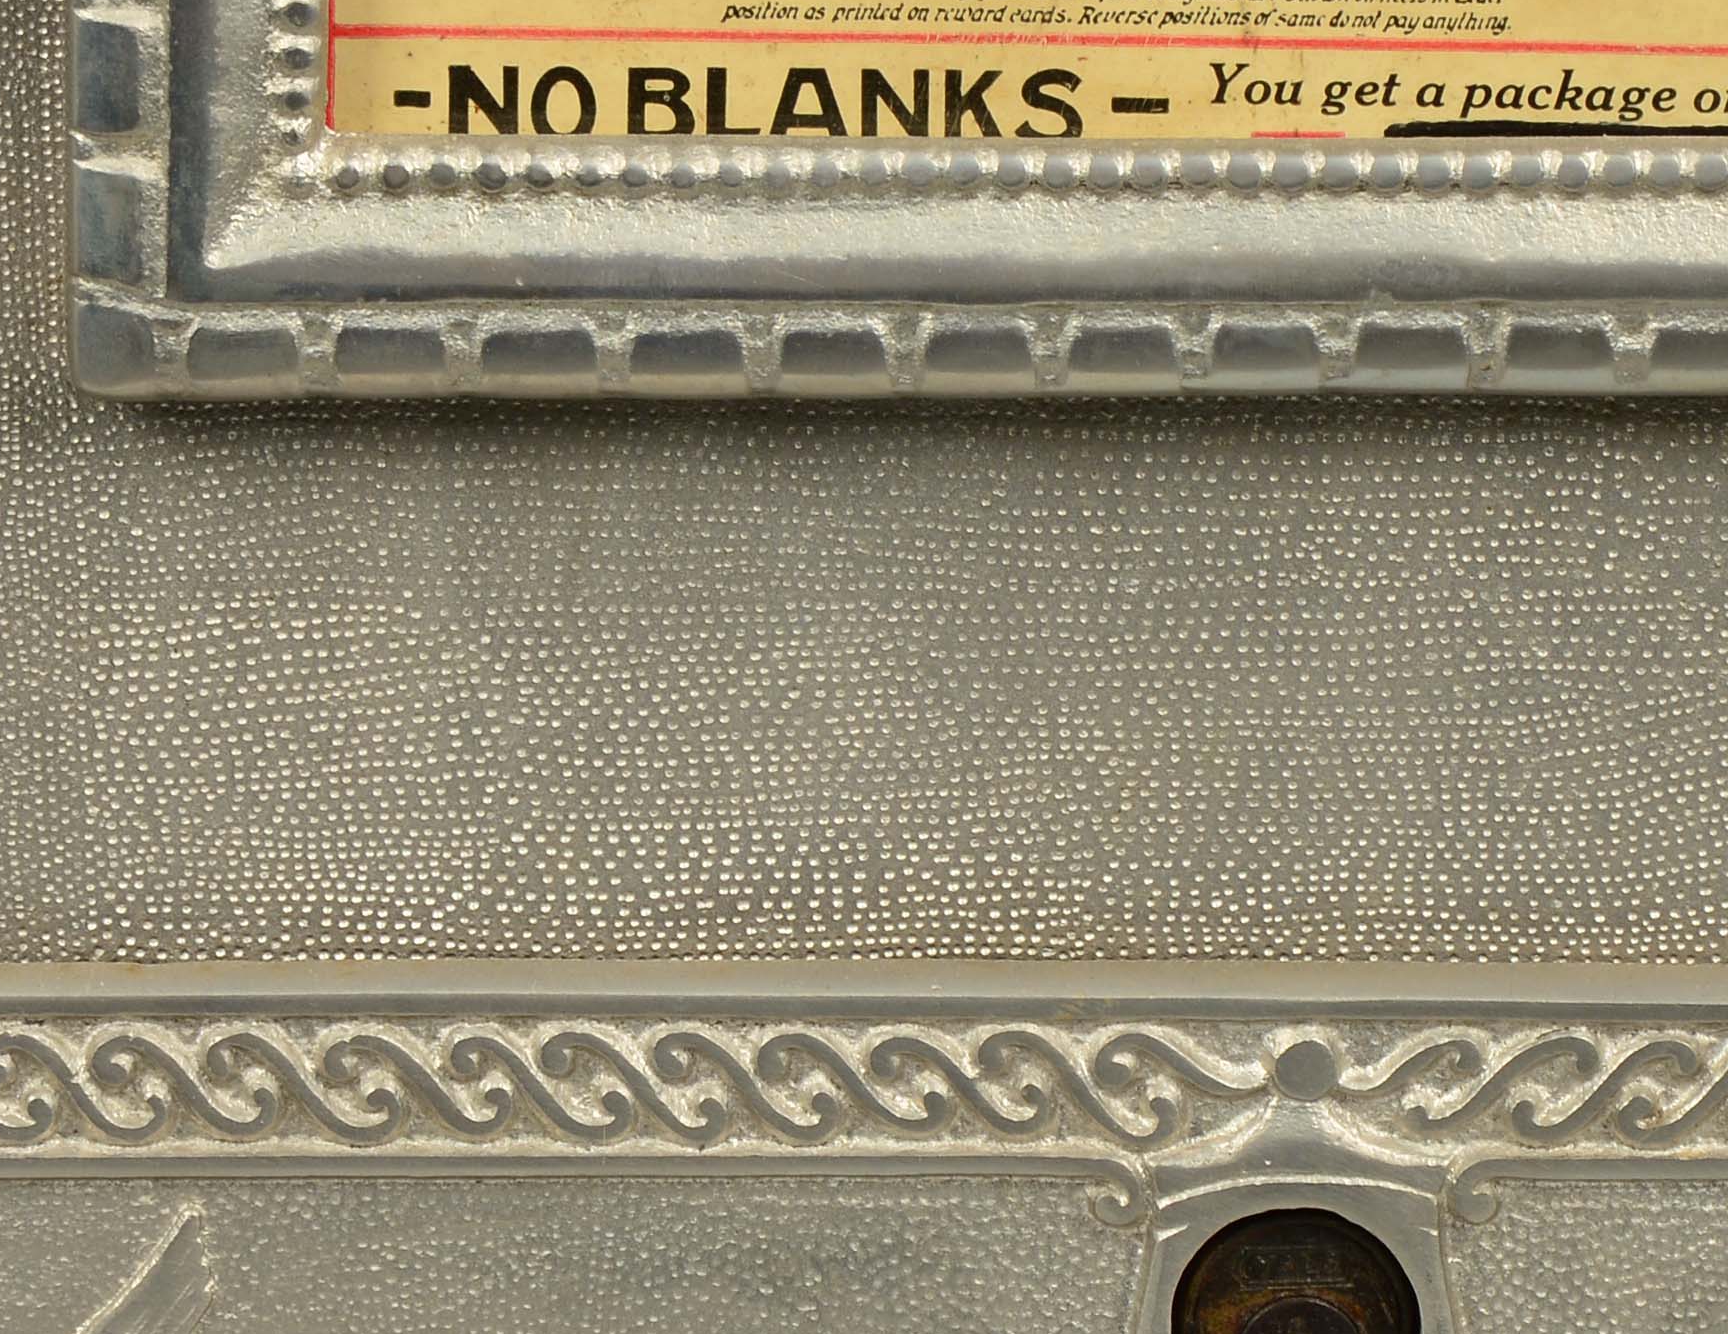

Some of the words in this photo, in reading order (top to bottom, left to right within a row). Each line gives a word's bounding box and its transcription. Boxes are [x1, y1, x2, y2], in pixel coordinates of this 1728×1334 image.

[721, 1, 799, 23] position
[804, 6, 825, 20] as
[832, 3, 904, 22] printed
[907, 6, 930, 22] on
[937, 6, 1007, 23] reward
[1077, 6, 1159, 25] Reverse
[1158, 6, 1252, 29] positions
[1329, 10, 1350, 28] do
[1353, 10, 1381, 28] not
[1382, 15, 1420, 35] pay
[1209, 62, 1303, 106] You
[1321, 73, 1401, 116] get
[1416, 83, 1446, 108] a
[1459, 69, 1677, 123] package
